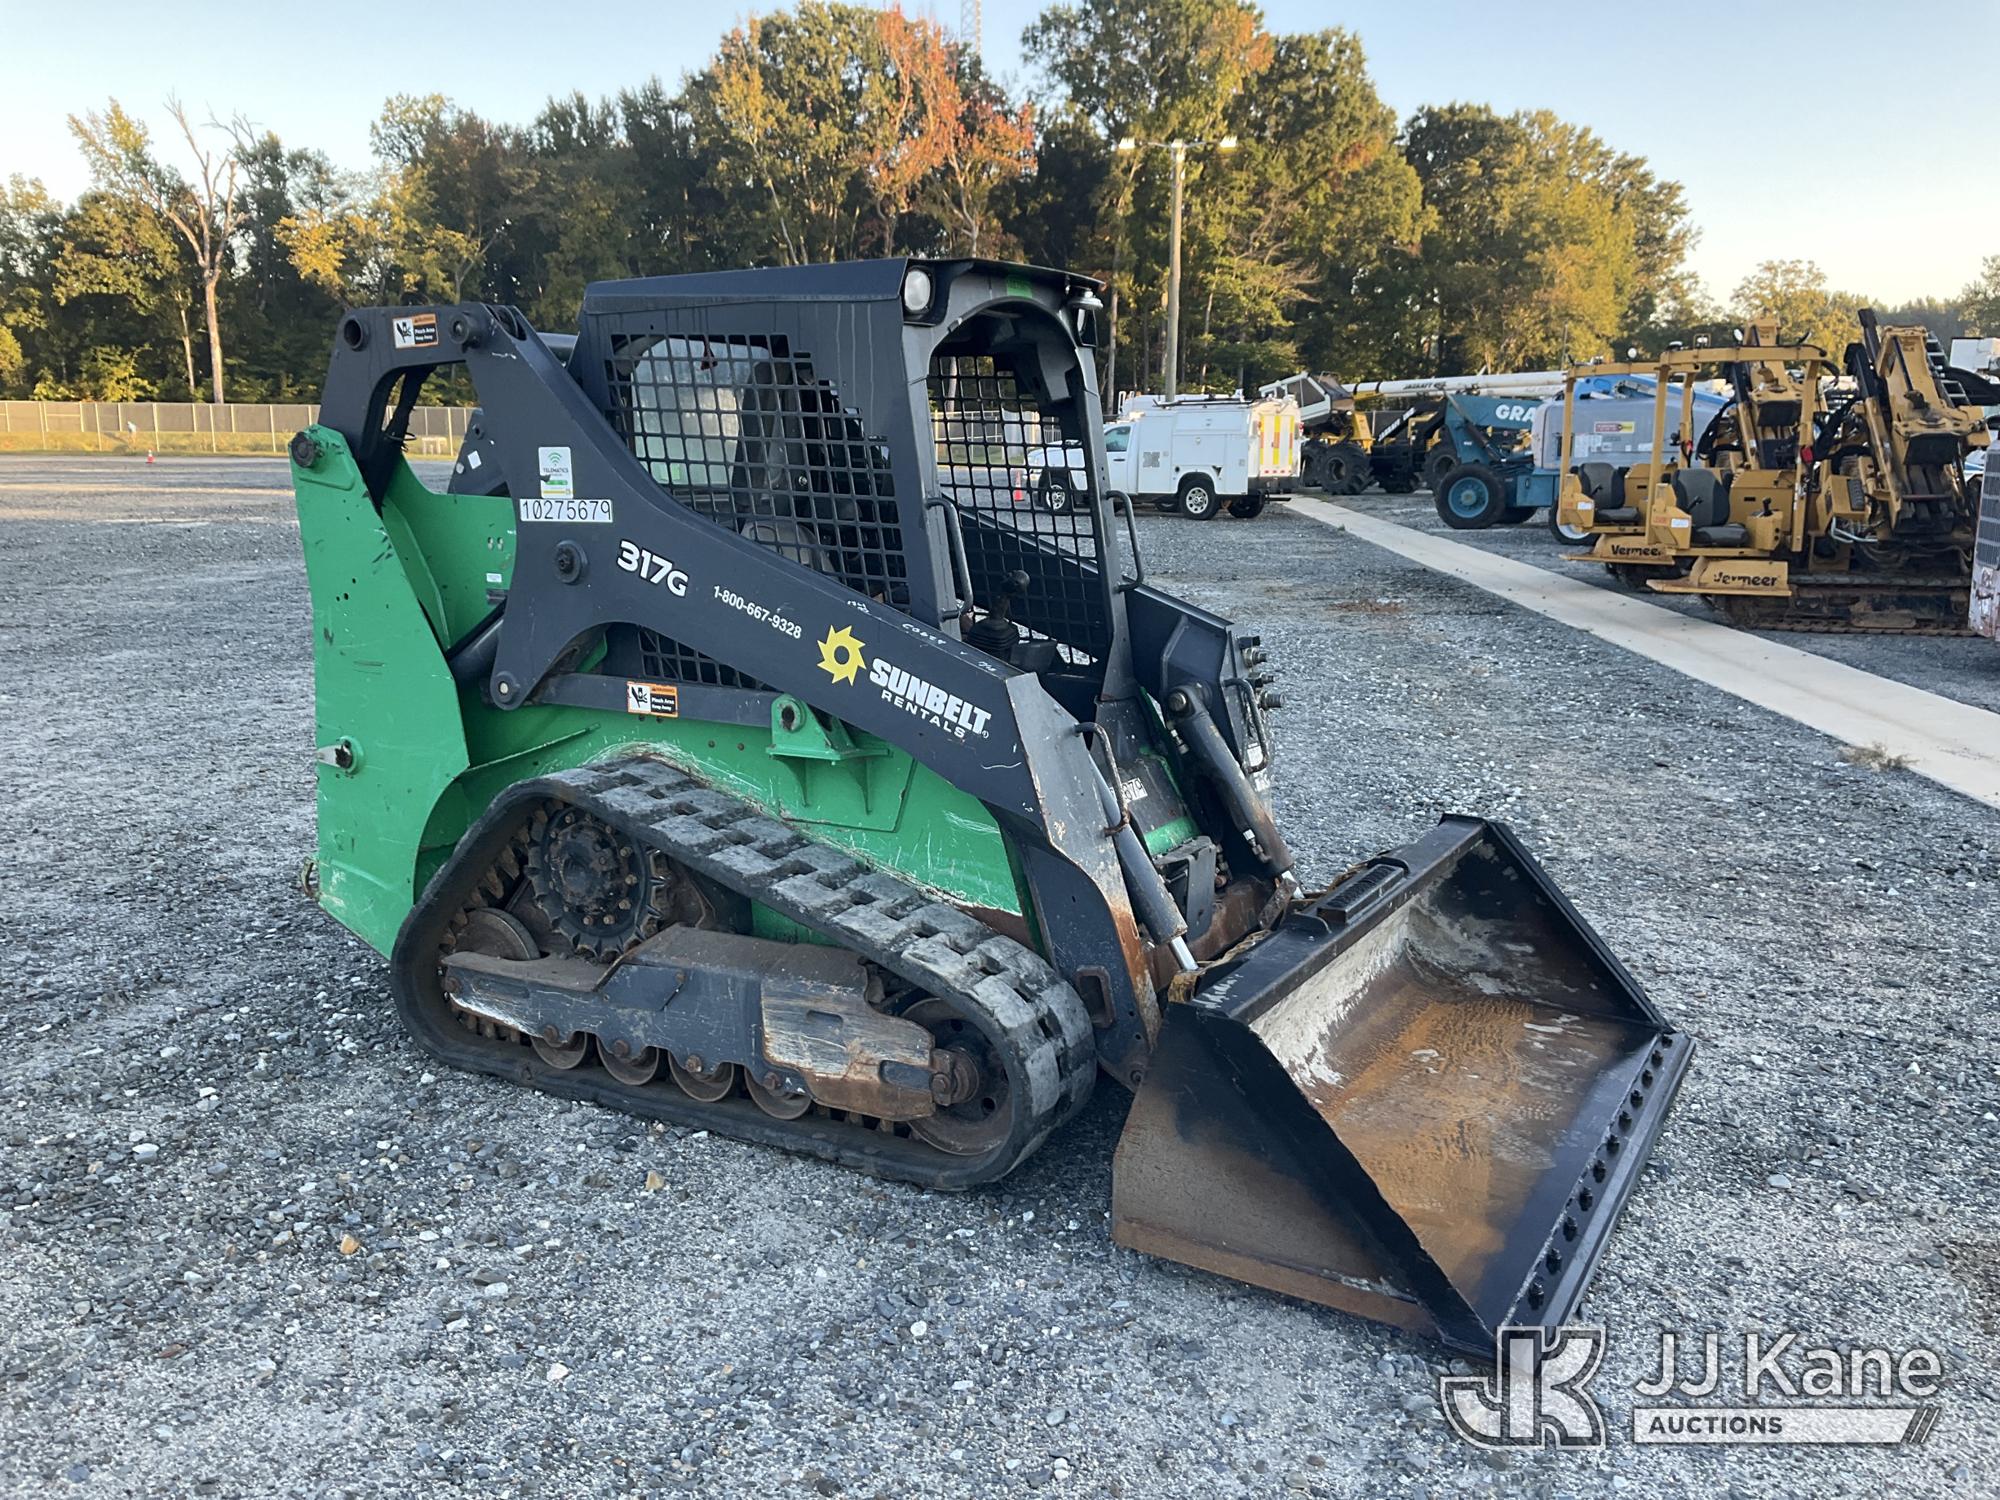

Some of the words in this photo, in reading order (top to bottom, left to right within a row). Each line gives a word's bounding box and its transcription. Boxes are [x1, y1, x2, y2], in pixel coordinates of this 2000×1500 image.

[522, 500, 611, 521] 10275679
[617, 539, 689, 598] 317G
[713, 585, 802, 640] 1-800-667-9328
[869, 658, 992, 735] SUNBELT
[881, 689, 966, 739] RENTALS
